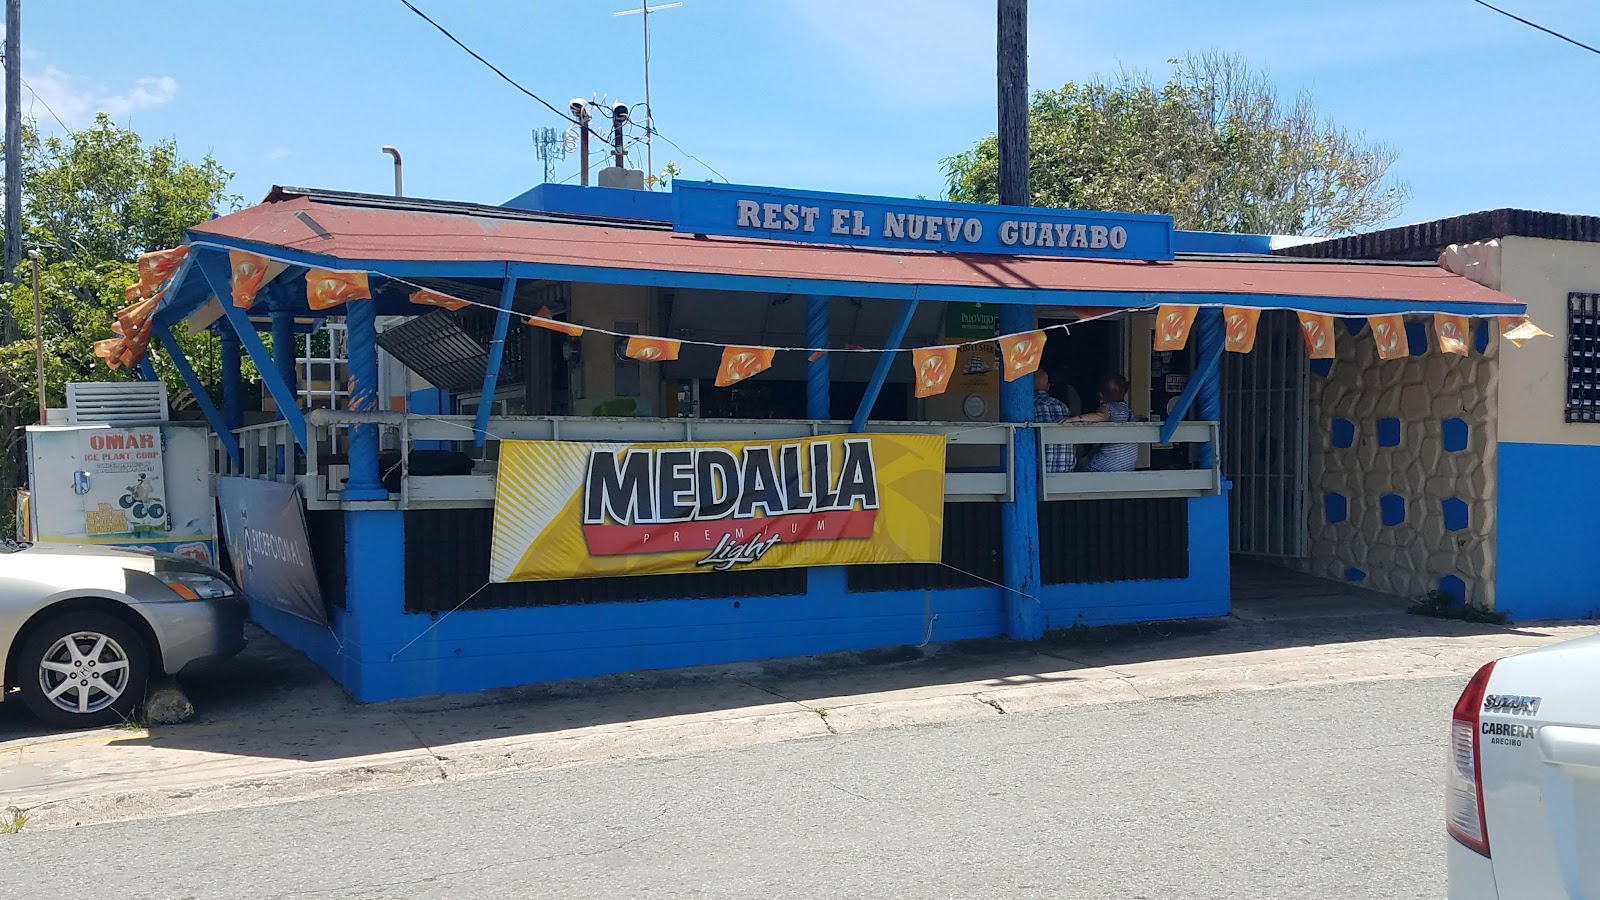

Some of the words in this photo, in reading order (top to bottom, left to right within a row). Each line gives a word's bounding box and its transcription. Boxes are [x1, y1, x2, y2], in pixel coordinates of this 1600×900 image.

[736, 199, 819, 232] REST
[831, 208, 870, 237] EL
[882, 211, 983, 243] NUEVO
[1000, 220, 1128, 250] GUAYABO
[90, 432, 154, 450] OMAR
[84, 454, 99, 462] ICE
[584, 439, 878, 525] MEDALLA
[251, 529, 304, 567] EXCEPCIONAL
[696, 531, 782, 572] Light
[1481, 722, 1534, 739] CABRERA
[1490, 737, 1522, 747] ARECIBO
